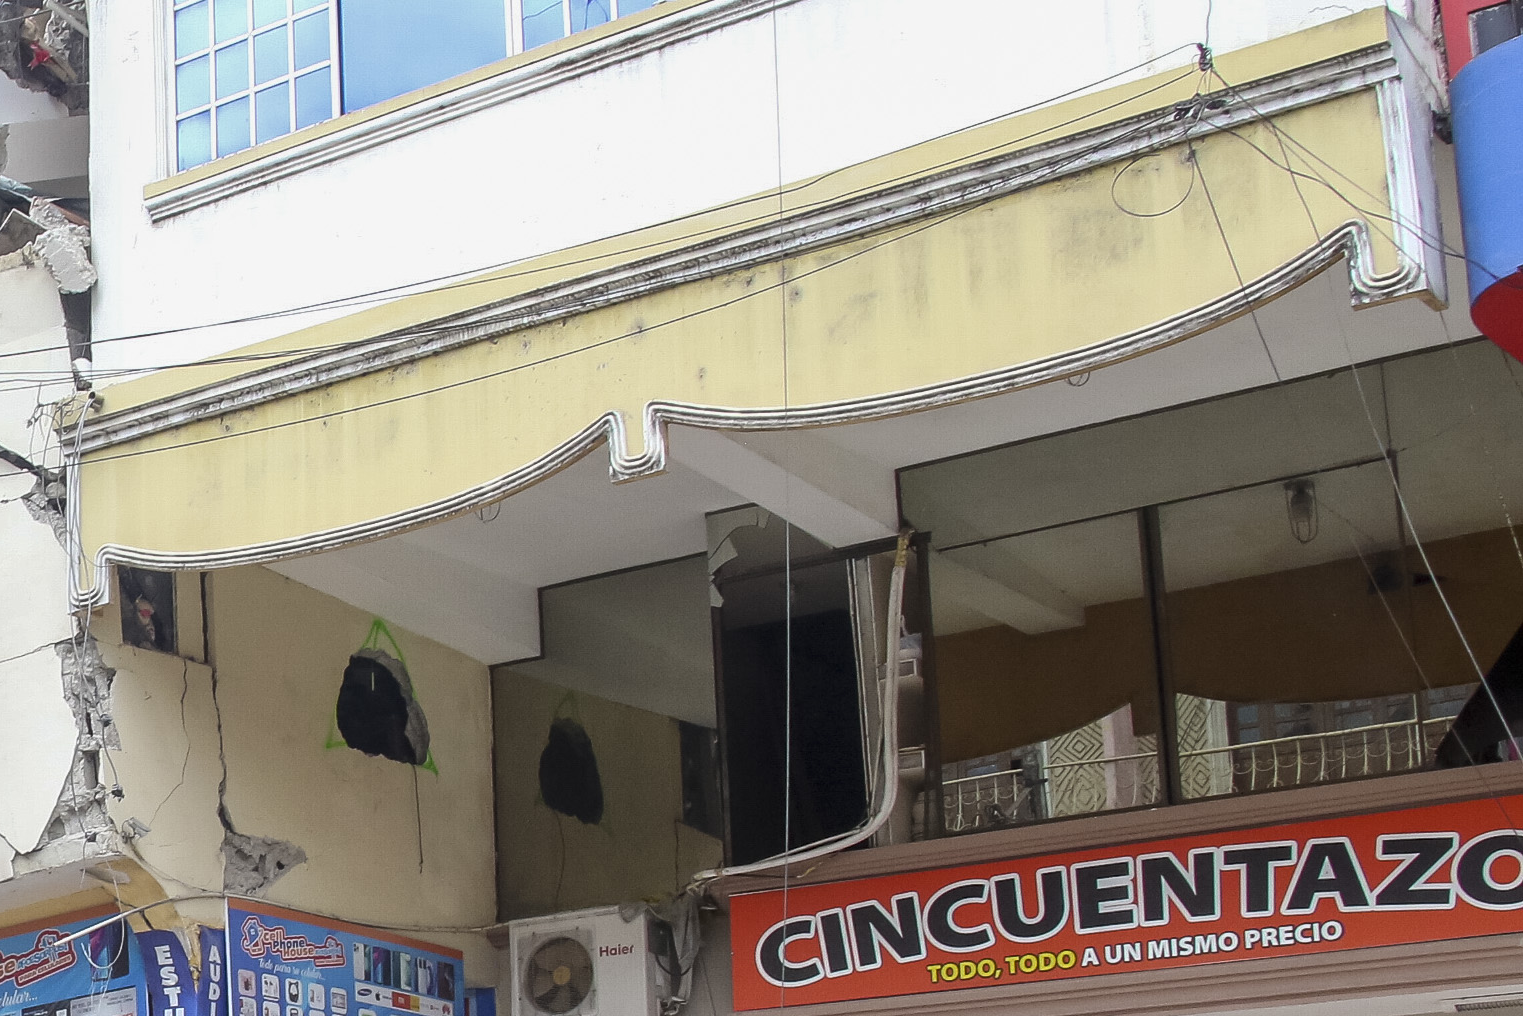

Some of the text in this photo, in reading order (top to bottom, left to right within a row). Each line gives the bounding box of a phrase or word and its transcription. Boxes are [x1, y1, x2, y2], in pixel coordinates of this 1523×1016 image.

[755, 830, 1523, 988] CINCUENTAZO
[599, 943, 634, 958] Haier
[927, 920, 1344, 984] TODO, TODO A UN MISMO PRECIO
